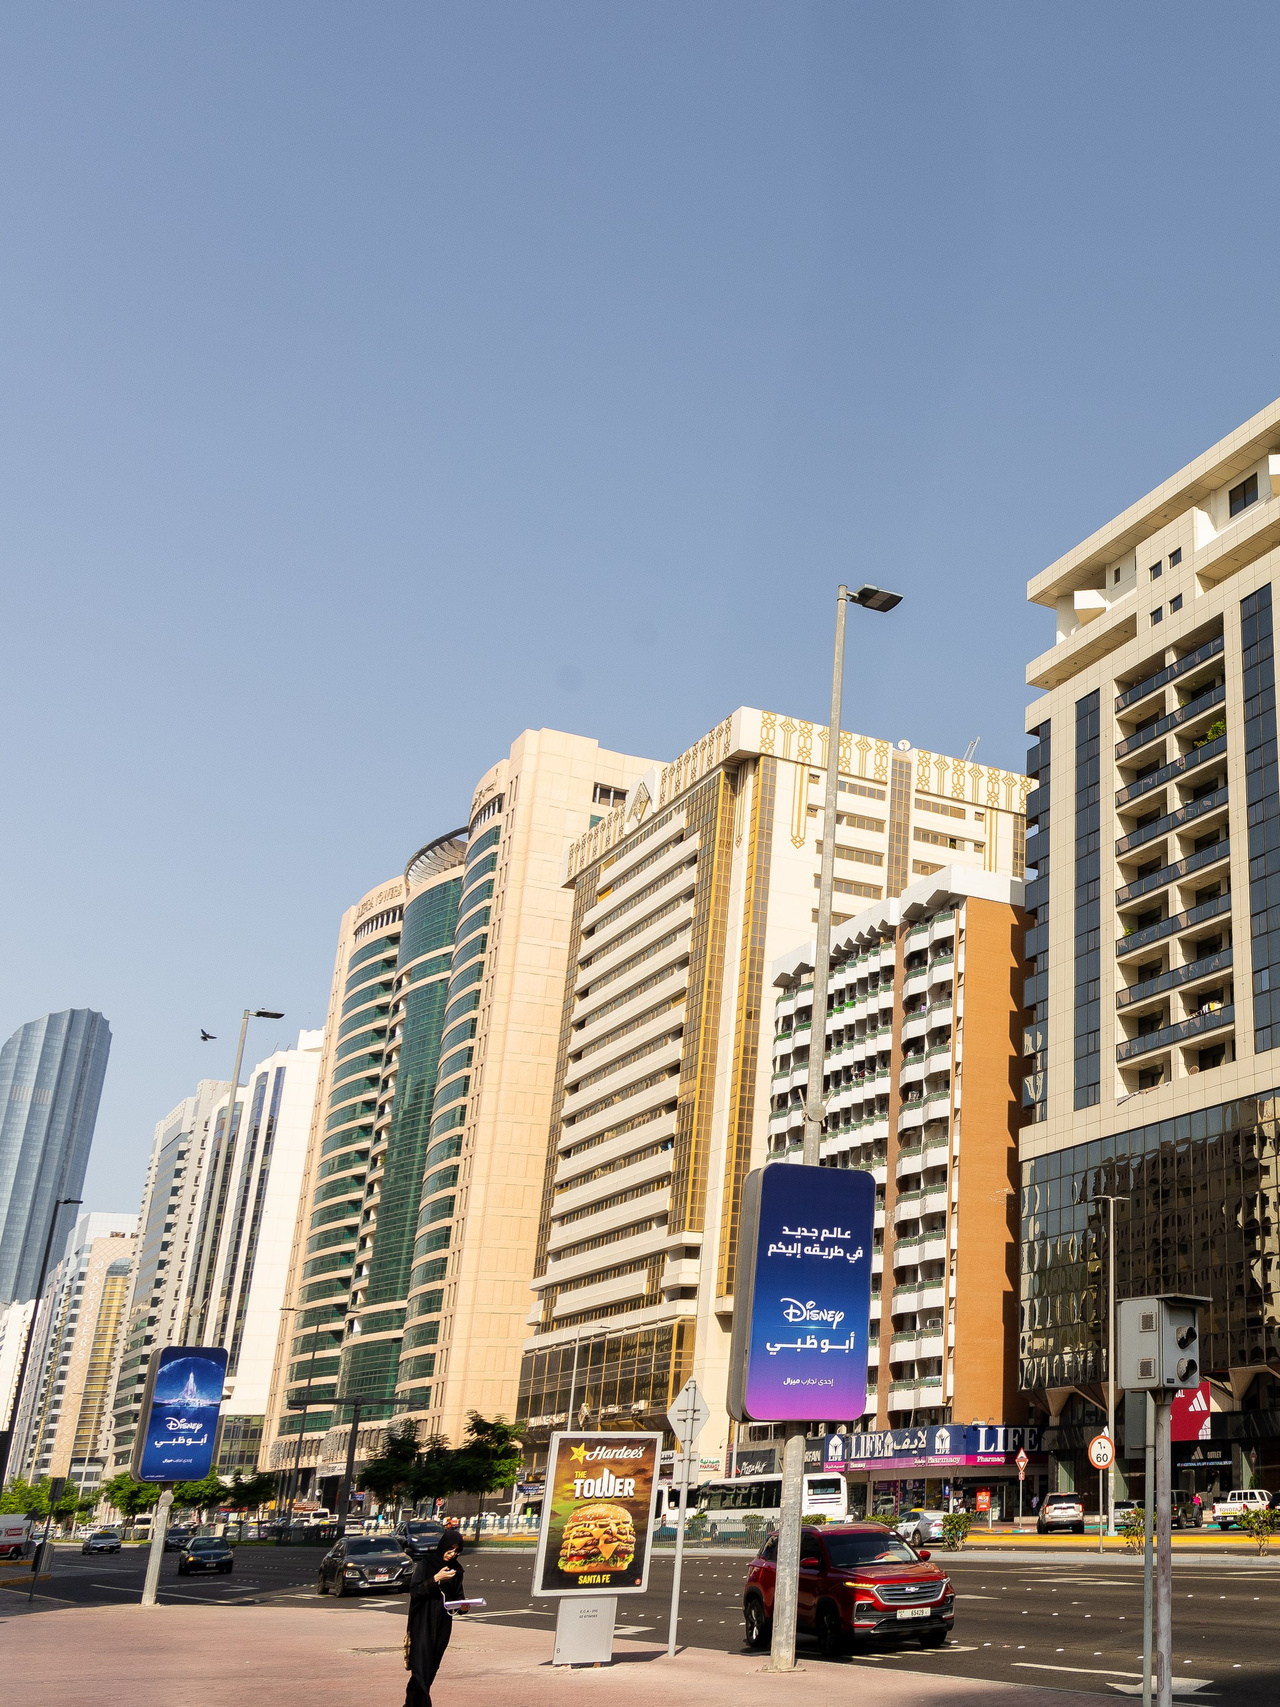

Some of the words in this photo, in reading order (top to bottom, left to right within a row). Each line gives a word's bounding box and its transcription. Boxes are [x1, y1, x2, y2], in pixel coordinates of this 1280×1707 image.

[782, 1226, 818, 1239] جديد
[820, 1227, 852, 1242] عالم
[768, 1242, 802, 1258] إليكم
[804, 1244, 844, 1259] طريقه
[846, 1246, 864, 1263] في
[780, 1298, 844, 1330] Disney
[766, 1334, 818, 1355] ظبي
[820, 1332, 855, 1354] أبو
[165, 1416, 203, 1433] Disney
[154, 1436, 186, 1448] ظبي
[186, 1434, 208, 1447] أبو
[850, 1433, 884, 1459] LIFE
[894, 1430, 927, 1455] لايف
[977, 1428, 1038, 1452] LIFE
[585, 1446, 645, 1460] Hardee's
[1096, 1454, 1108, 1462] 60
[574, 1468, 636, 1499] TOWER
[578, 1575, 600, 1584] SANTA
[602, 1574, 610, 1583] FE
